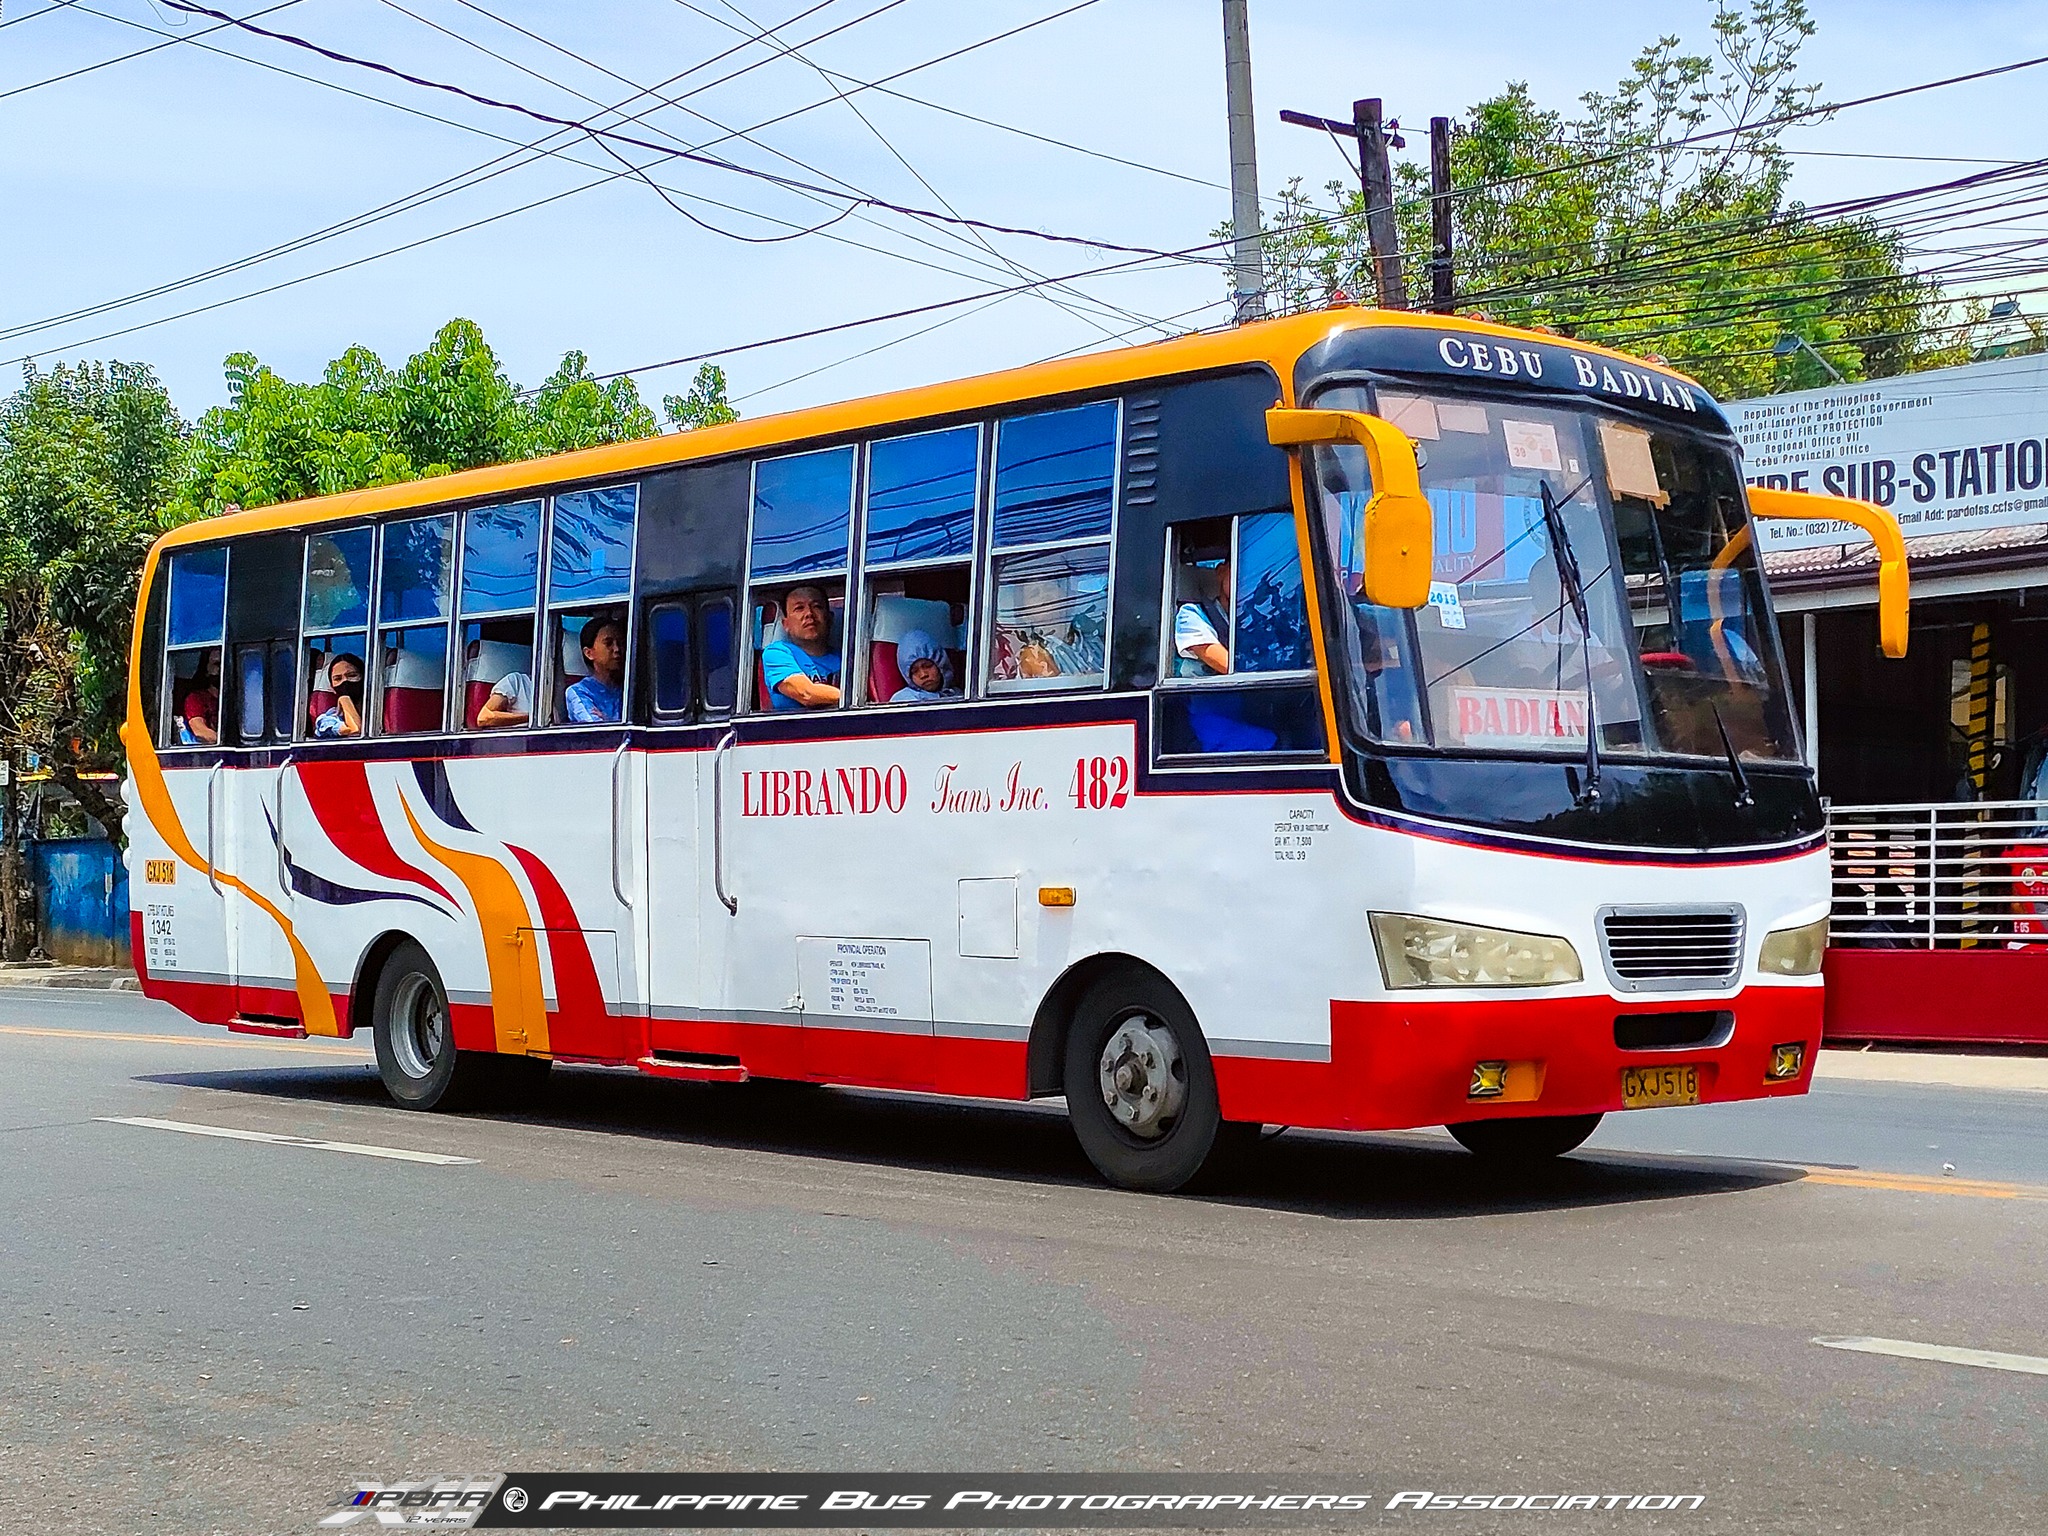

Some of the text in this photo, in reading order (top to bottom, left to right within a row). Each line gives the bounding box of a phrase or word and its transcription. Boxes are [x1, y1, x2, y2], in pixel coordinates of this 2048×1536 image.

[1439, 337, 1698, 412] CEBU BADIAN
[1744, 392, 1882, 420] Republic of the Philippines
[1758, 420, 1767, 430] of
[1772, 416, 1811, 429] Interior
[1817, 410, 1834, 422] and
[1838, 405, 1865, 419] Local
[1870, 396, 1933, 414] Government
[1743, 416, 1883, 445] BUREAU OF FIRE PROTECTION
[1765, 441, 1807, 455] Regional
[1812, 434, 1841, 448] Office
[1755, 443, 1870, 467] Cebu Provincial Office
[1823, 438, 2048, 507] SUB-STATIO
[1898, 511, 1922, 525] Email
[1924, 508, 1944, 522] Add:
[1770, 527, 1784, 539] Tel.
[1806, 523, 1830, 537] (032)
[1458, 696, 1585, 738] BADIAN
[742, 756, 1130, 817] LIBRANDO Trans Inc. 482
[151, 919, 172, 935] 1342
